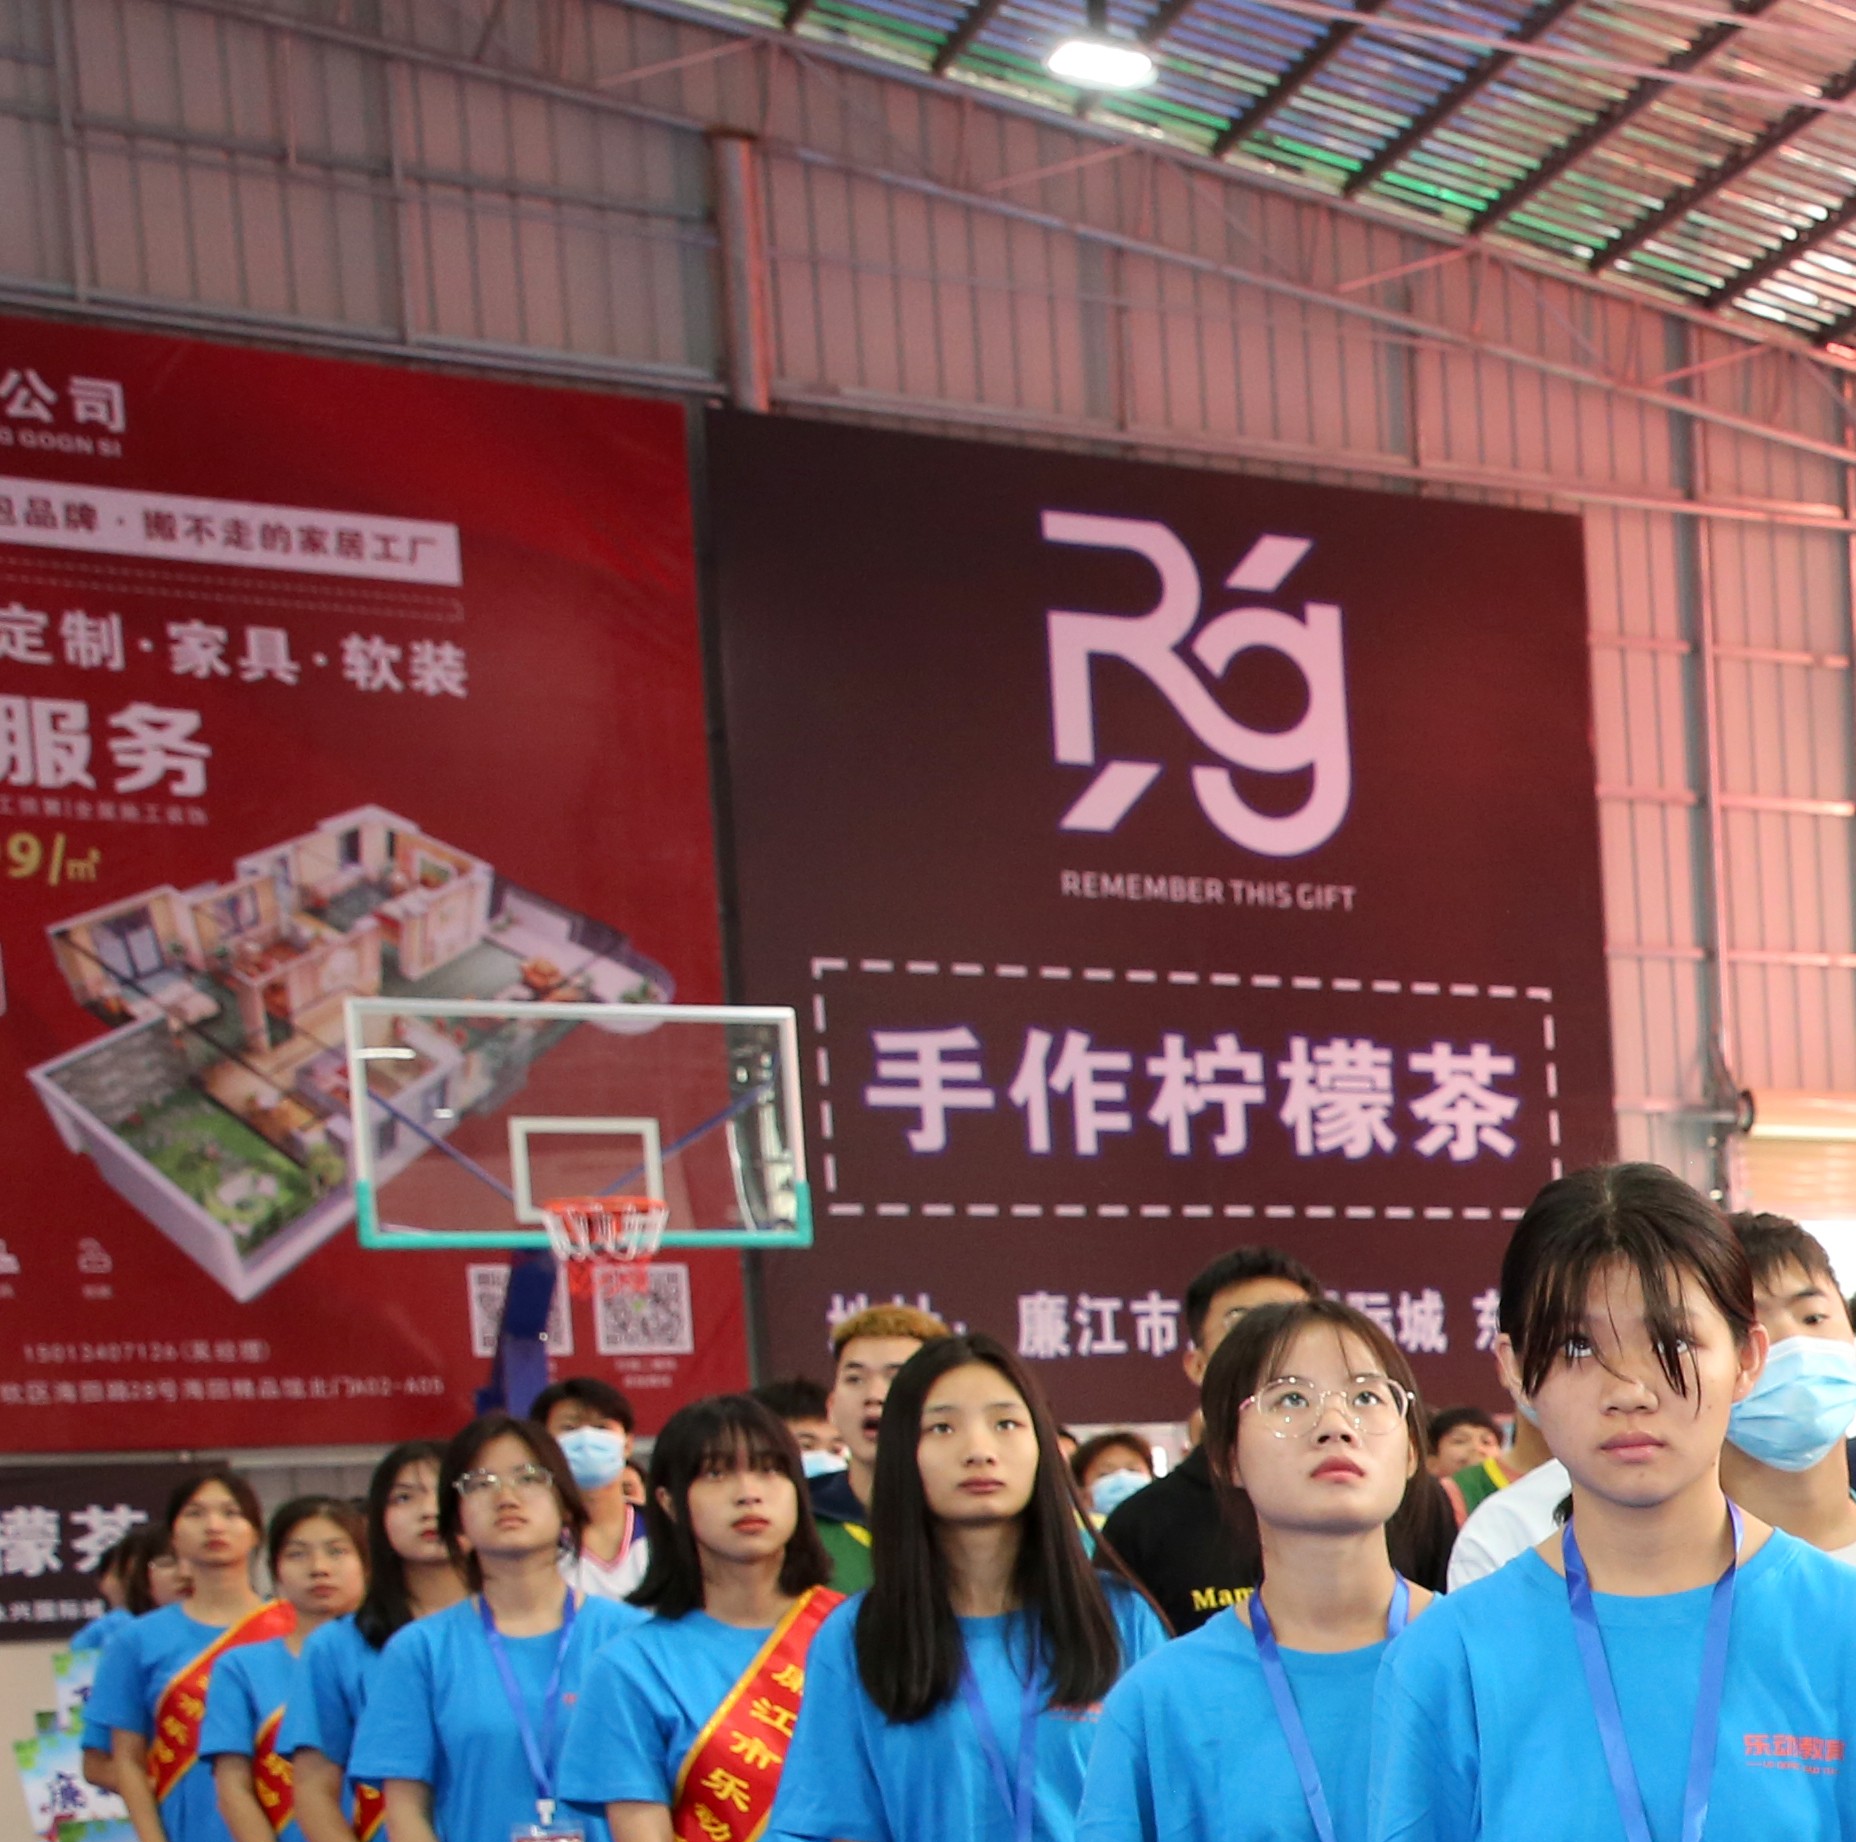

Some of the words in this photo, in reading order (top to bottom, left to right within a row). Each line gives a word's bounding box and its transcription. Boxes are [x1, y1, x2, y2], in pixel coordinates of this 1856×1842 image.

[0, 368, 126, 433] 公司
[0, 693, 213, 797] 服务
[1060, 869, 1224, 905] REMEMBER
[1229, 879, 1292, 909] THIS
[1296, 882, 1356, 911] GIFT
[865, 1026, 1520, 1161] 手作柠檬茶
[1743, 1732, 1846, 1762] 乐动教育
